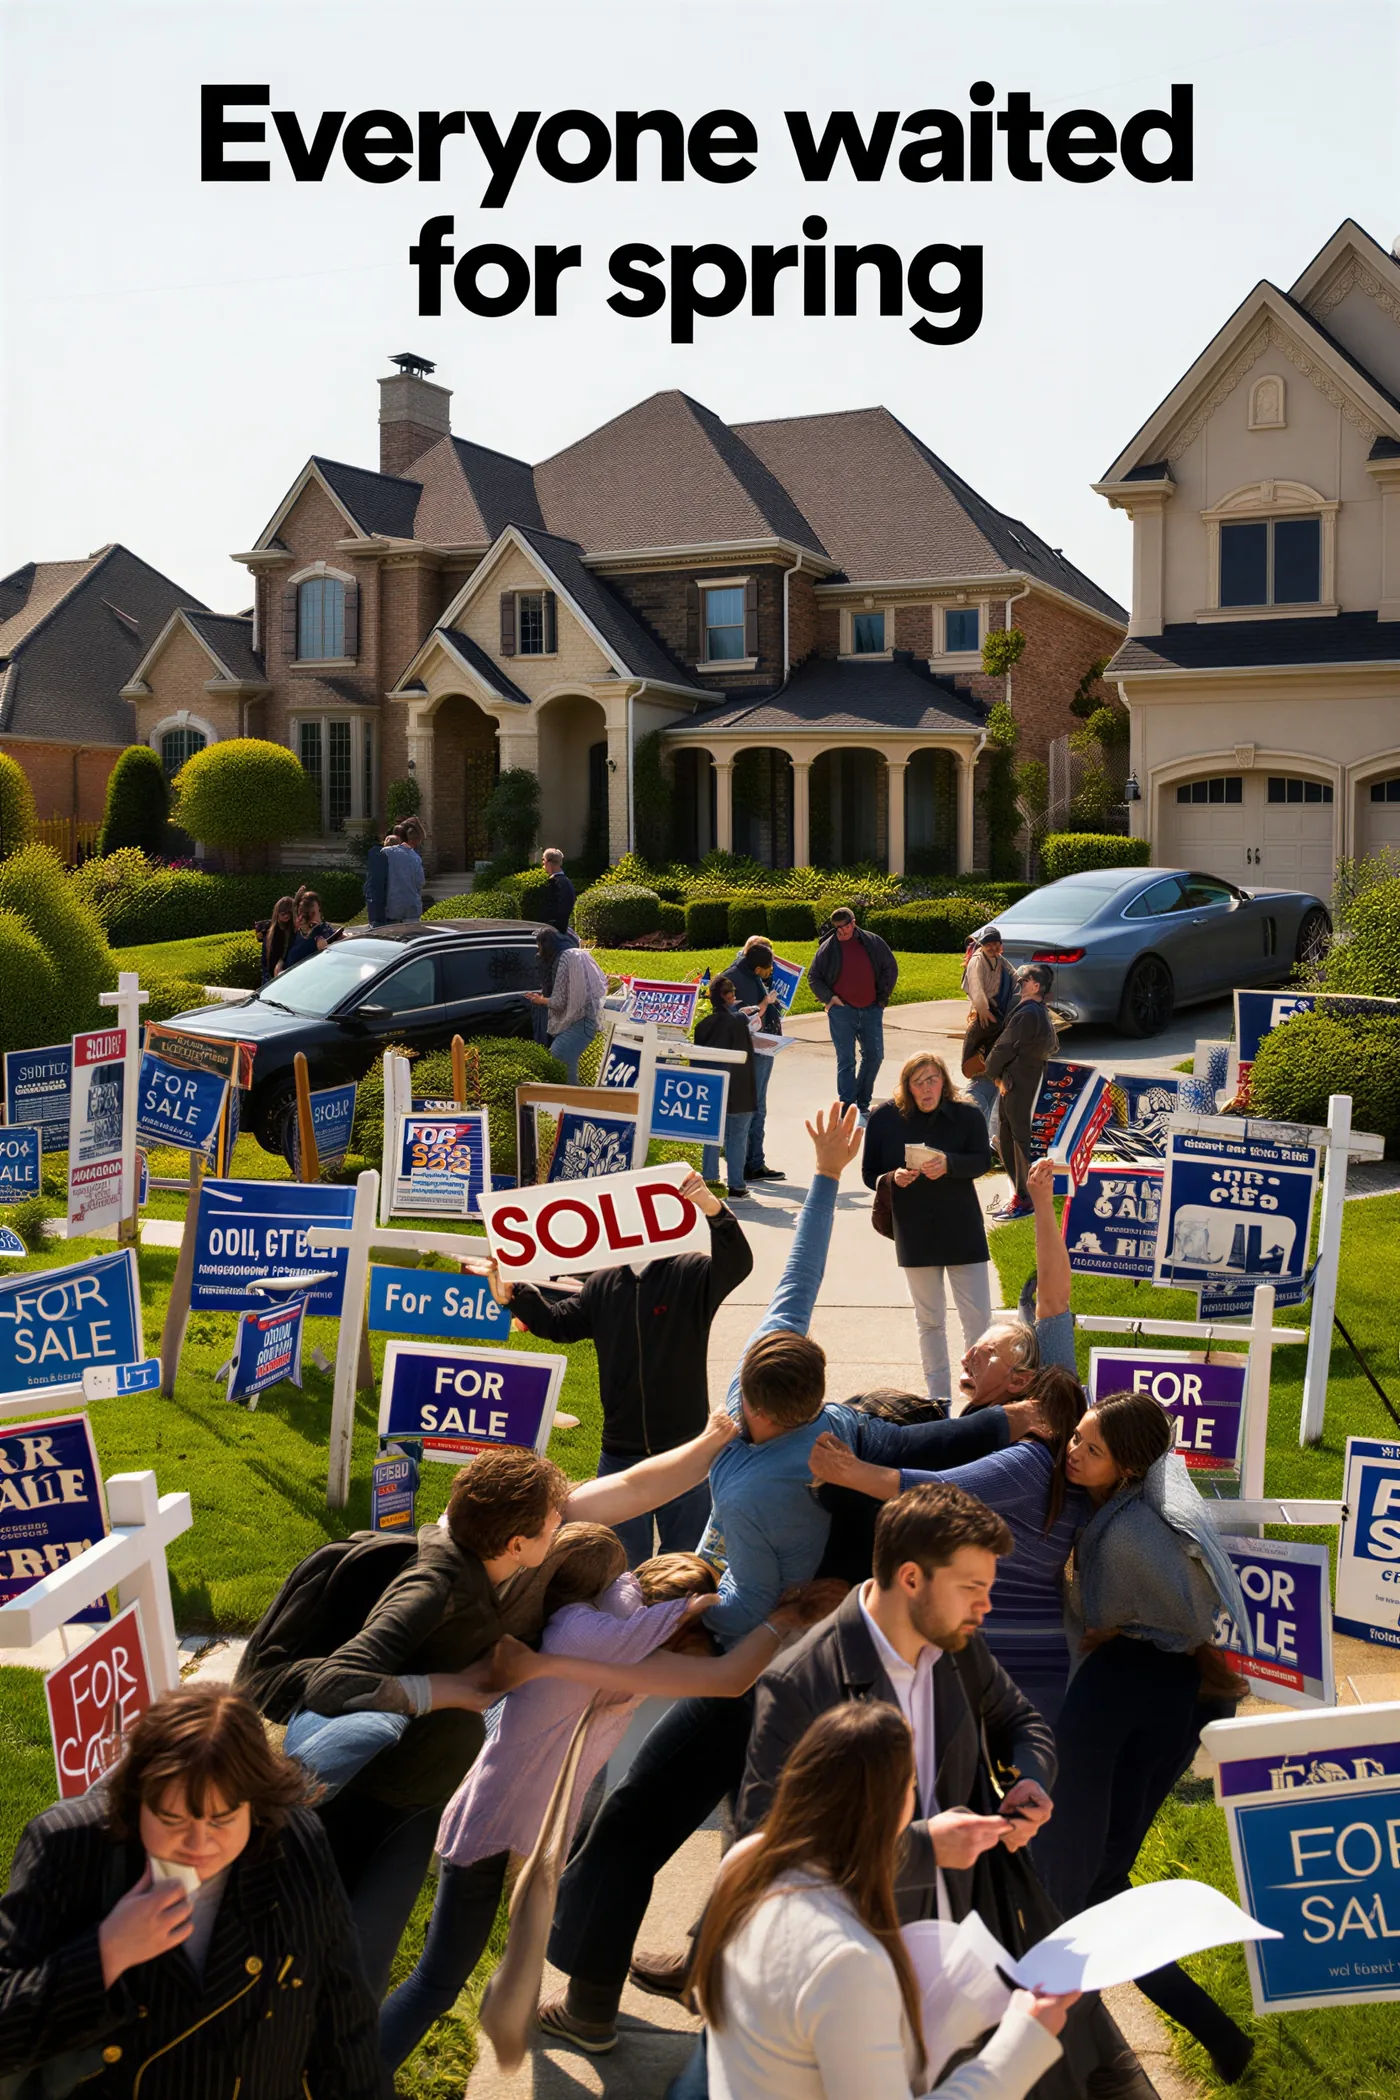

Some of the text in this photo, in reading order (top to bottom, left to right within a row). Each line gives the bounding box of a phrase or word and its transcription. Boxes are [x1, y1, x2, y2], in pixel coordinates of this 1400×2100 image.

[151, 1069, 198, 1100] FOR
[663, 1079, 710, 1102] FOR
[143, 1090, 201, 1126] SALE
[658, 1099, 711, 1122] SALE
[491, 1183, 697, 1267] SOLD
[14, 1275, 108, 1324] FOR
[385, 1283, 501, 1321] For Sale
[15, 1320, 116, 1364] SALE
[435, 1367, 504, 1400] FOR
[1133, 1369, 1203, 1407] FOR
[420, 1404, 509, 1438] SALE
[1170, 1414, 1216, 1450] LE
[1232, 1564, 1296, 1611] OR
[69, 1646, 138, 1742] FOR
